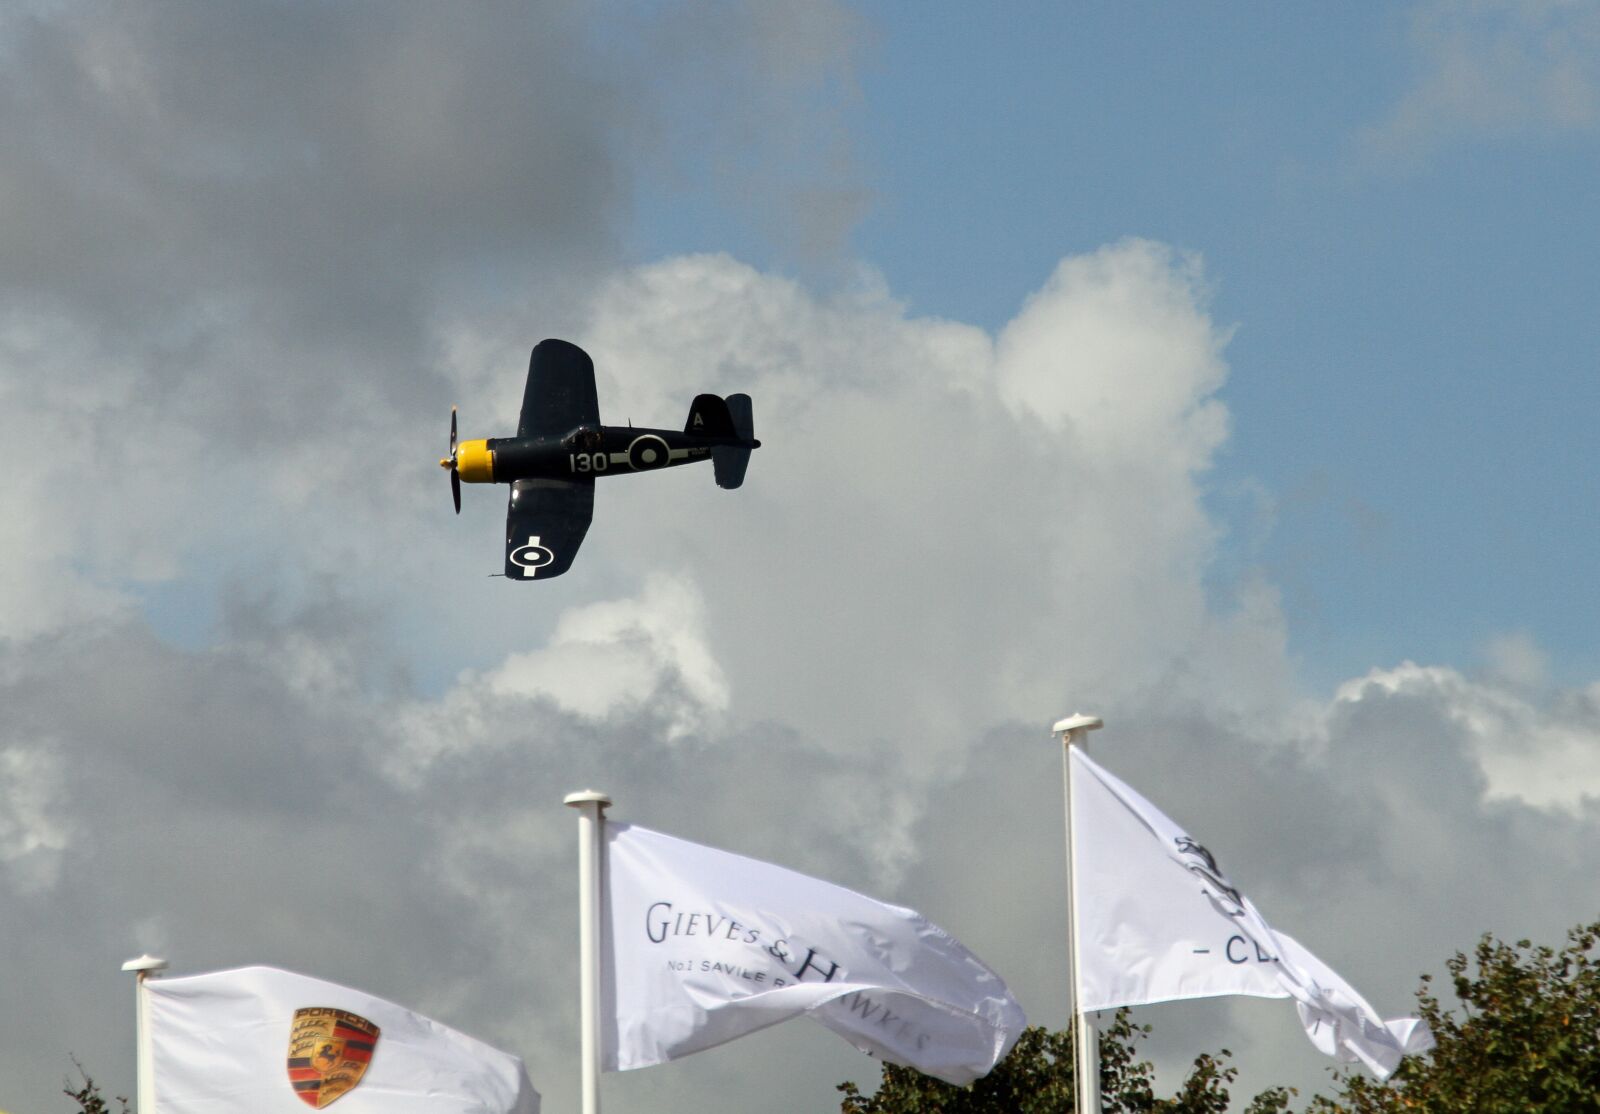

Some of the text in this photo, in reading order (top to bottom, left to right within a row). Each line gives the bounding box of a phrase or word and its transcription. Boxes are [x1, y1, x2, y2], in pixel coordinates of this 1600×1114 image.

[693, 411, 704, 426] A
[569, 452, 608, 473] 130
[645, 902, 761, 944] GIEVES
[767, 938, 788, 964] &
[1226, 935, 1279, 964] CL
[700, 960, 767, 983] SAVILE
